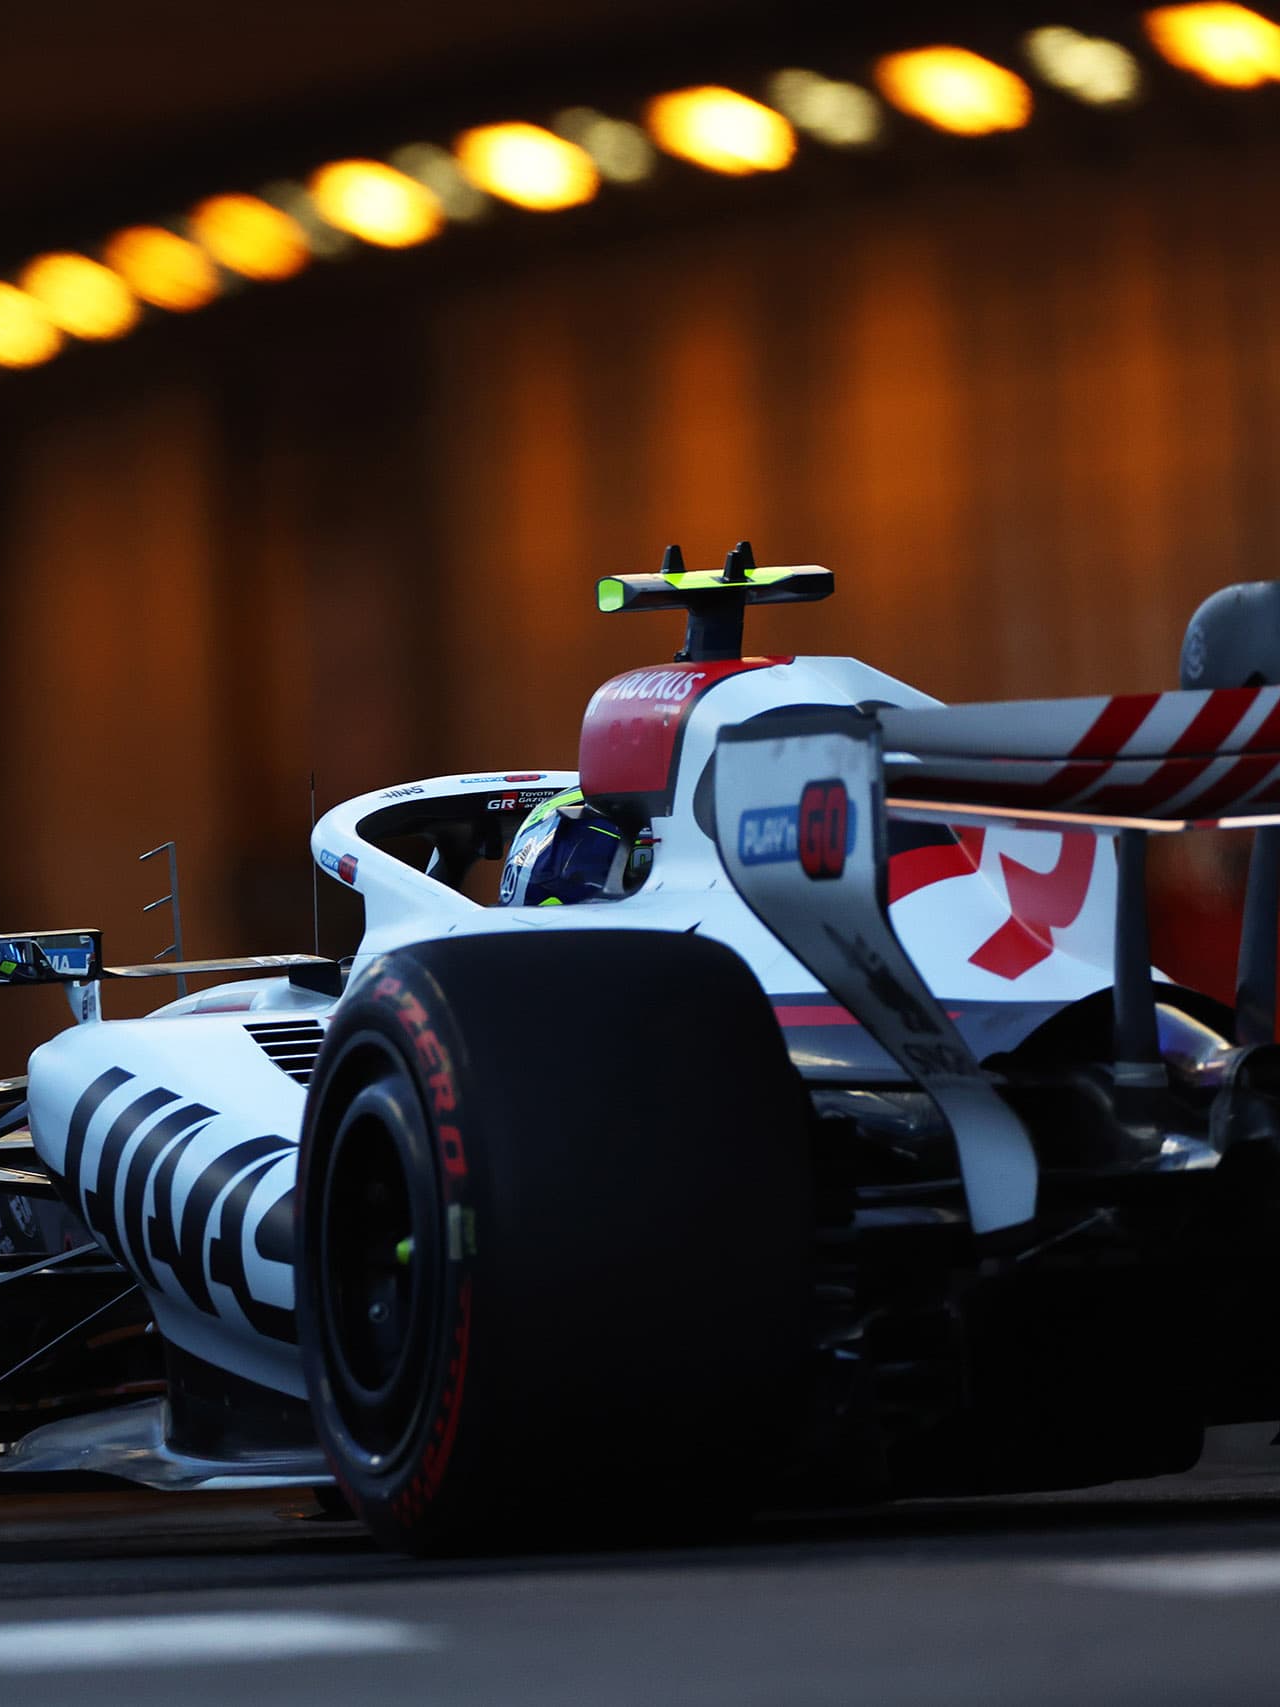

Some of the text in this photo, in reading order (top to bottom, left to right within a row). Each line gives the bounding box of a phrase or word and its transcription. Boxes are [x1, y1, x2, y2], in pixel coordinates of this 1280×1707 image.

[612, 671, 706, 701] RUCKUS
[487, 799, 516, 810] GR
[802, 785, 847, 874] GO
[396, 992, 470, 1177] ZERO
